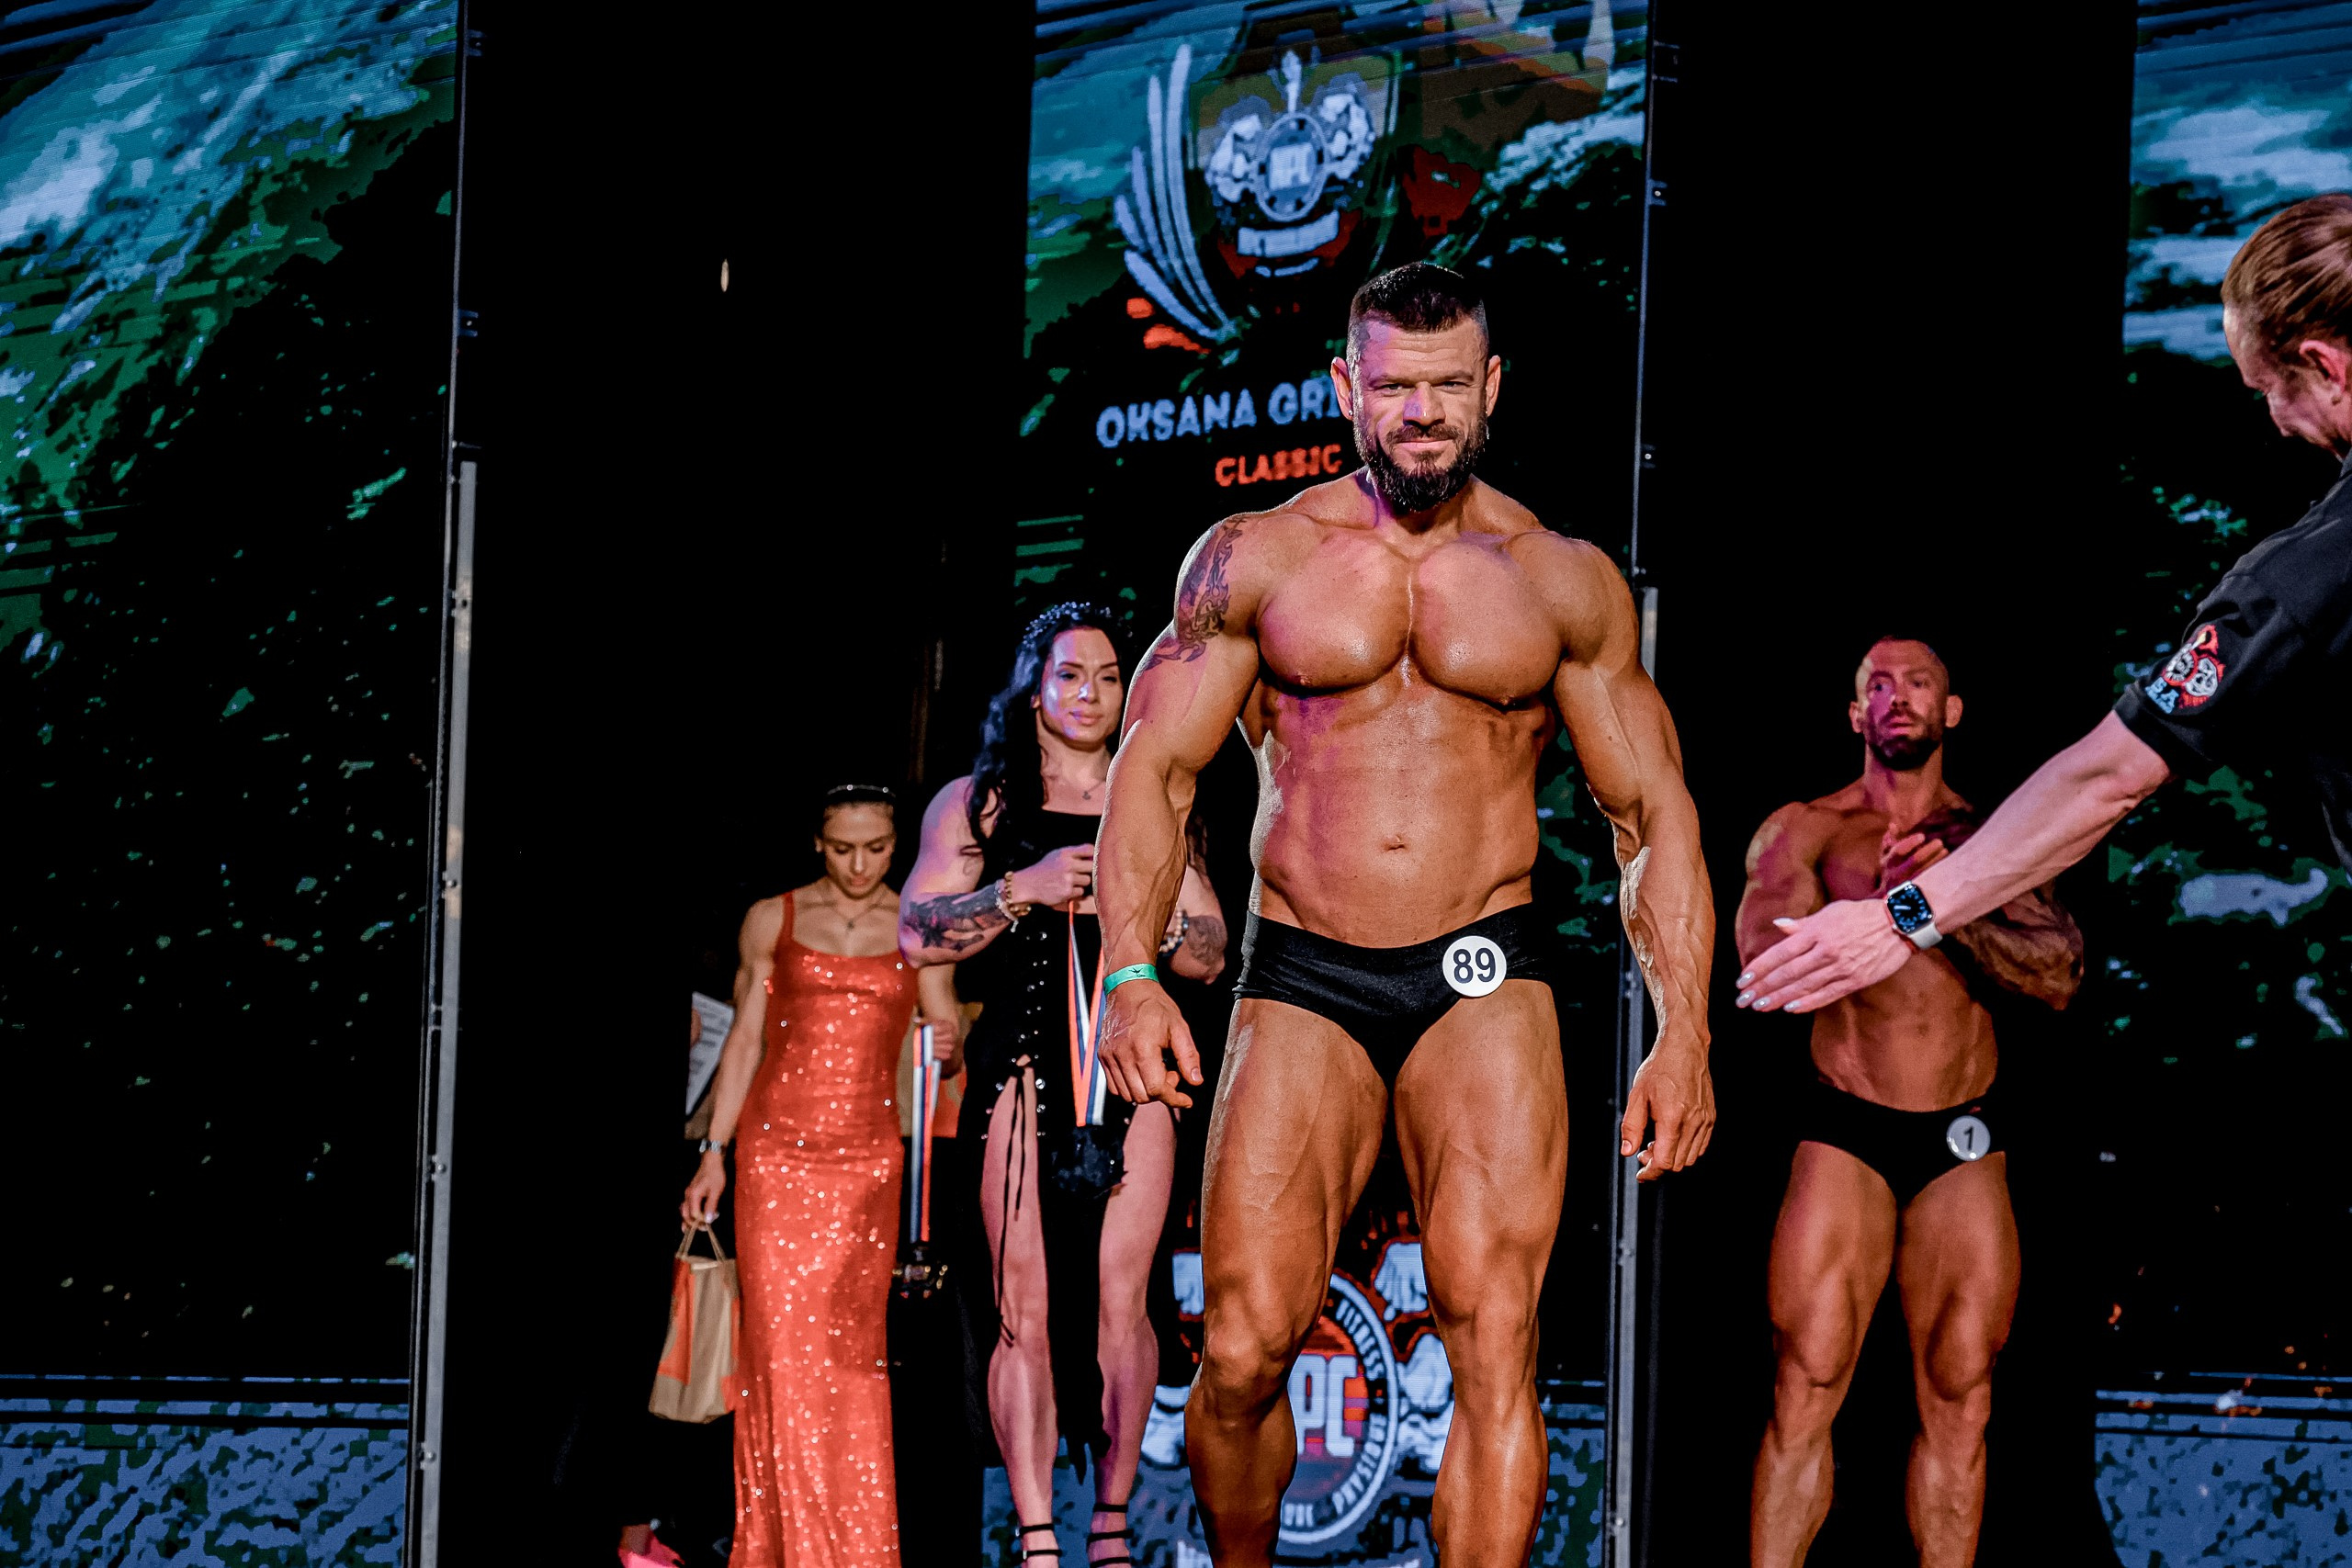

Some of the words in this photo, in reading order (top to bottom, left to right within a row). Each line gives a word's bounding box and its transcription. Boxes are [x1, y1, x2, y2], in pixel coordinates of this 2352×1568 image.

[1096, 388, 1258, 448] OKSANA
[1267, 375, 1340, 425] GRI
[1215, 444, 1343, 488] CLASSIC
[1453, 947, 1497, 984] 89
[1963, 1125, 1974, 1151] 1
[1286, 1354, 1358, 1457] PC
